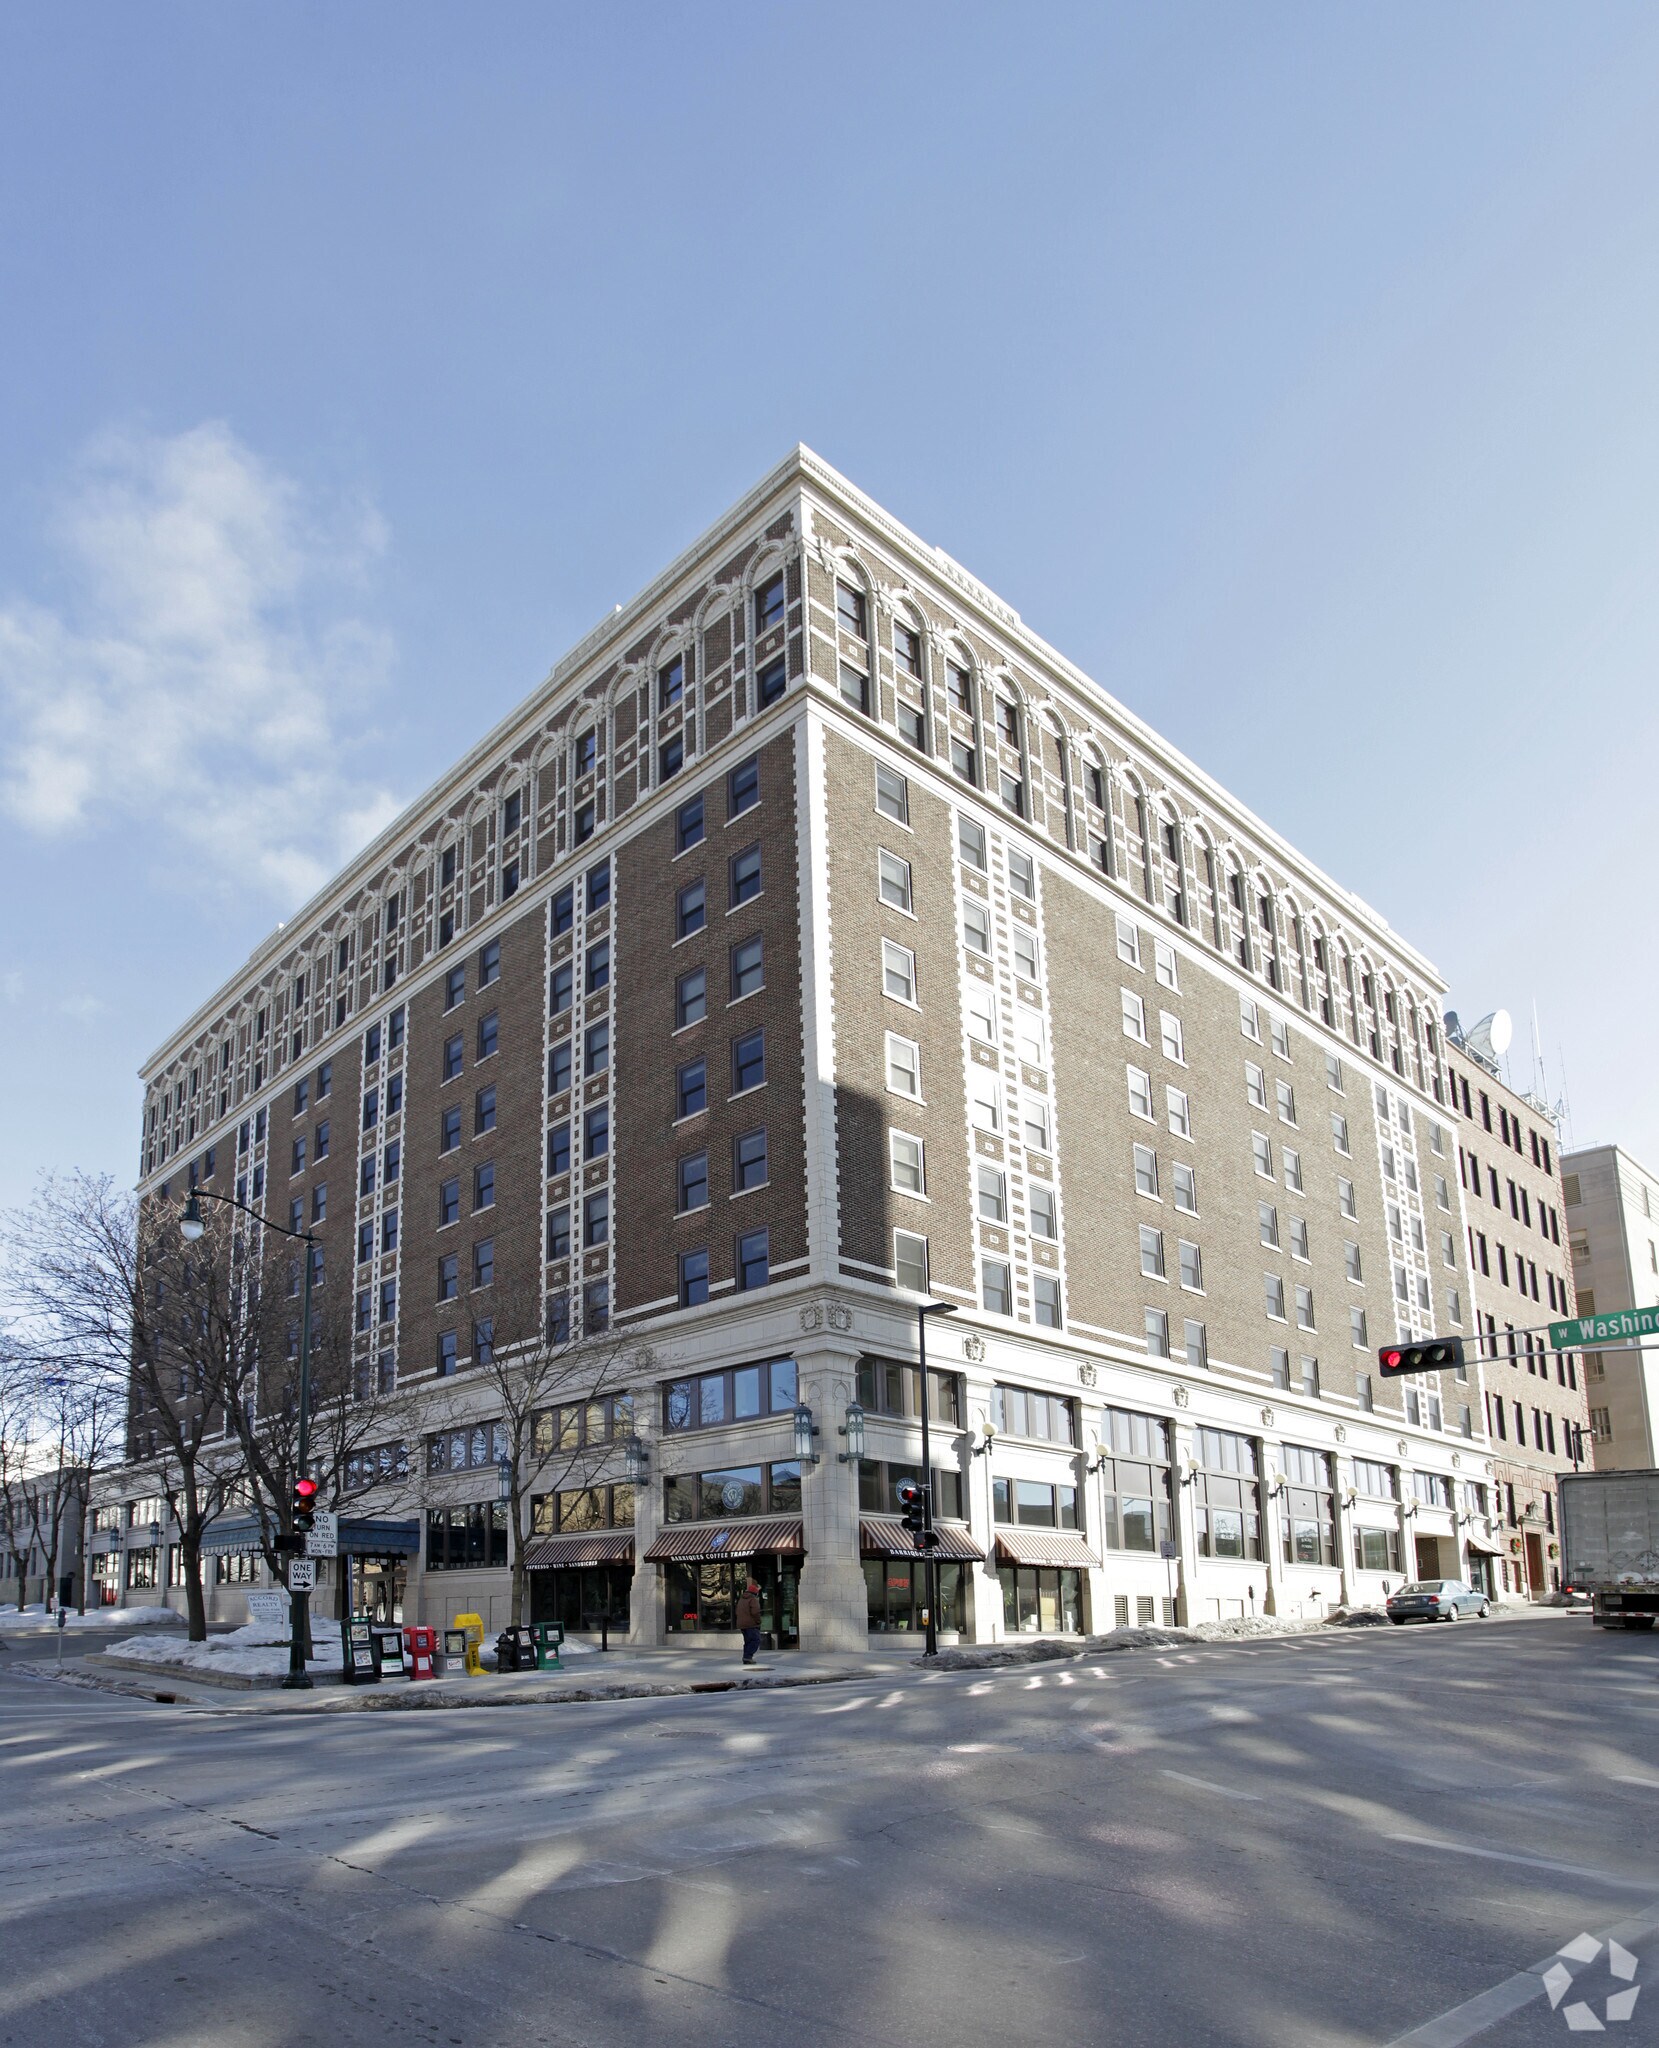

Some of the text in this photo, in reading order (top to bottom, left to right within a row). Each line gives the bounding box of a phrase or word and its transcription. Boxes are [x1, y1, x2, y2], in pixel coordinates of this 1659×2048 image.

[1558, 1328, 1568, 1338] W
[315, 1515, 329, 1523] NO
[671, 1550, 755, 1562] BARRIQUES COFFEE TRADER
[293, 1563, 312, 1571] ONE
[292, 1572, 312, 1580] WAY
